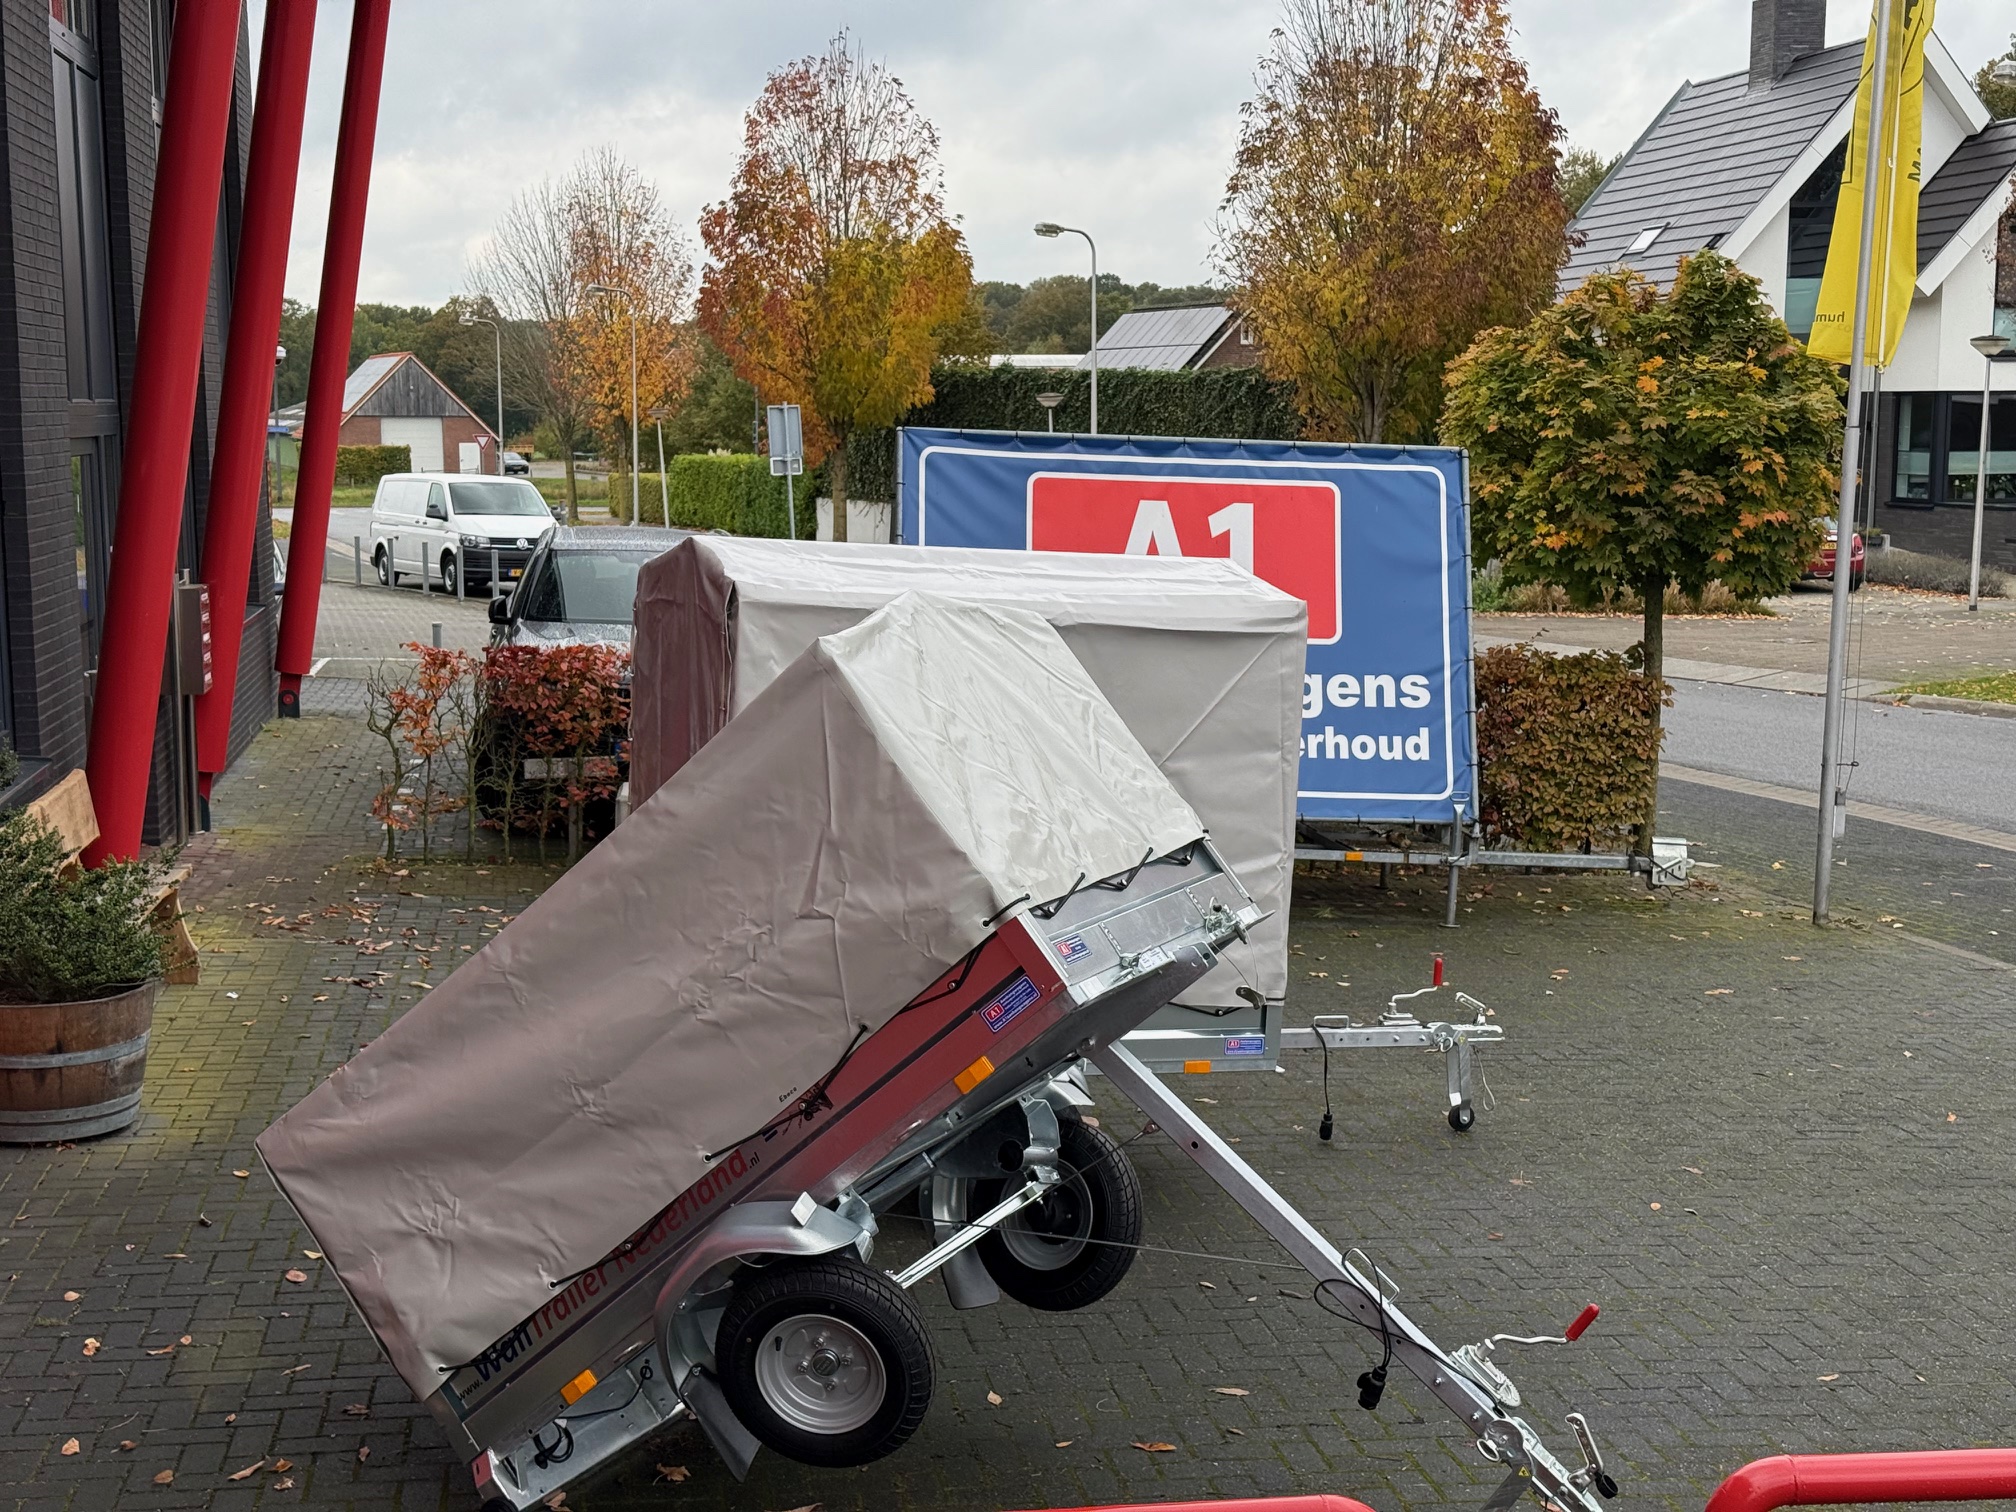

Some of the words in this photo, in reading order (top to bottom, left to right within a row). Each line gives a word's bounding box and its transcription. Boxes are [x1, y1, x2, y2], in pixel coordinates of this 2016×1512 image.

[1125, 499, 1254, 574] A1
[1302, 673, 1431, 719] gens
[1299, 726, 1430, 761] rhoud
[990, 1006, 1001, 1019] A1
